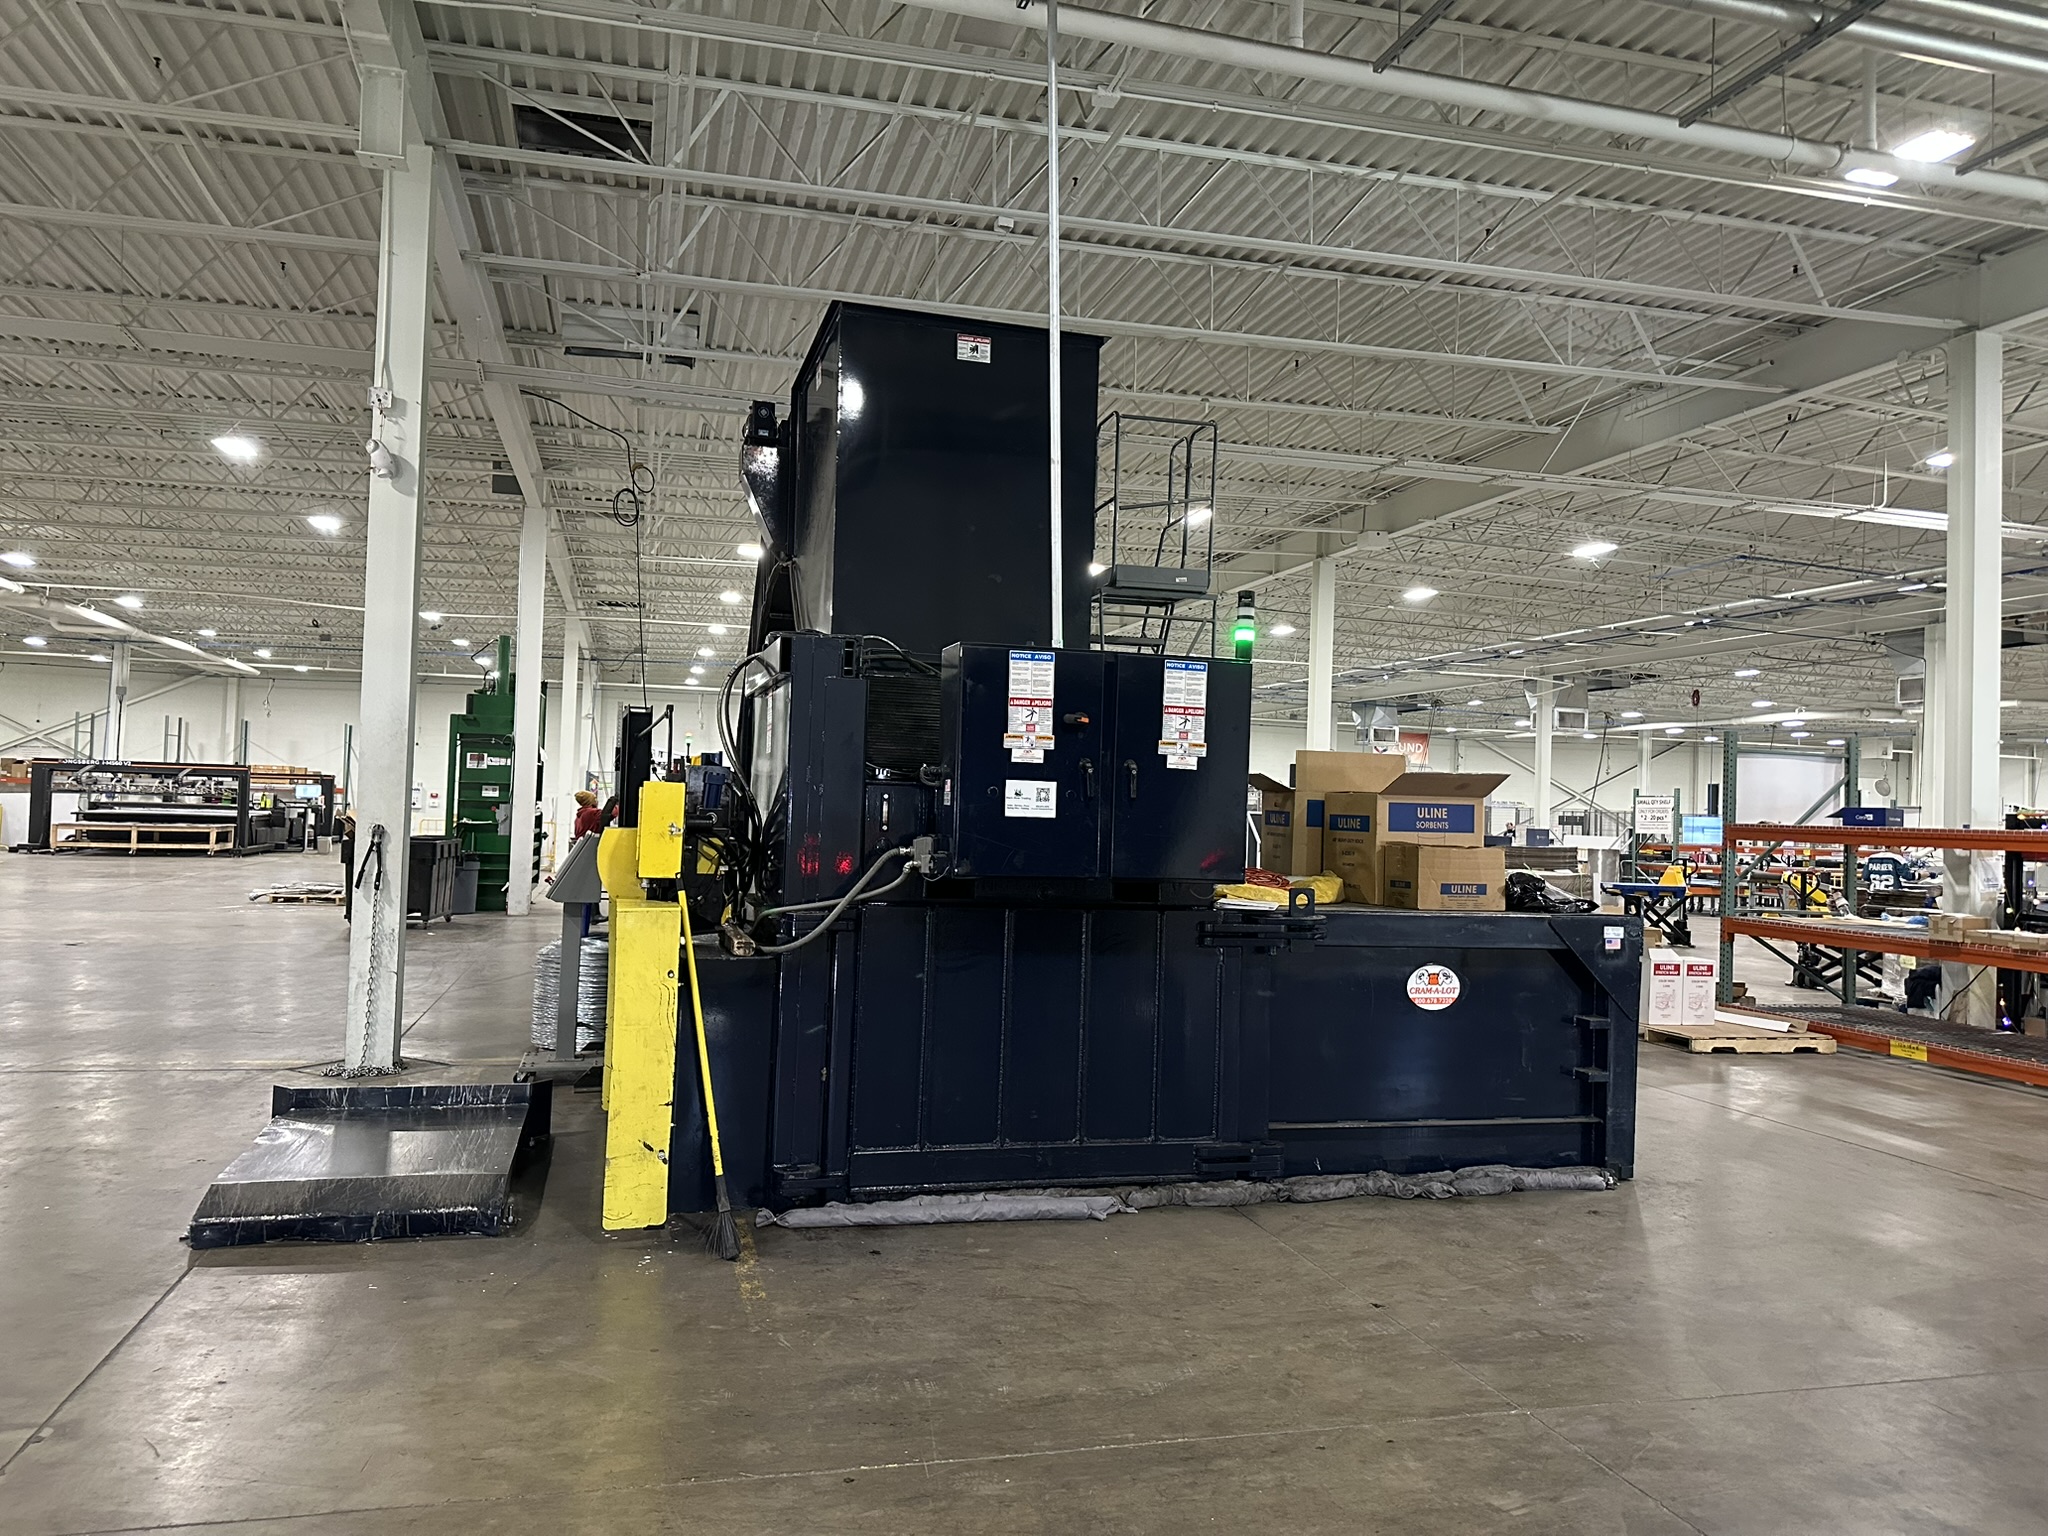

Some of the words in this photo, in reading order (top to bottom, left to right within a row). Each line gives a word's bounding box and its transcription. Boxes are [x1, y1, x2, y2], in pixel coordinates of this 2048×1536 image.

[1417, 807, 1448, 818] ULINE
[1269, 813, 1286, 824] ULINE
[1338, 817, 1361, 829] ULINE
[1416, 821, 1449, 830] SORBENTS
[1868, 863, 1893, 871] PARKER
[1451, 885, 1477, 893] ULINE
[1409, 986, 1457, 995] CRAM-A-LOT
